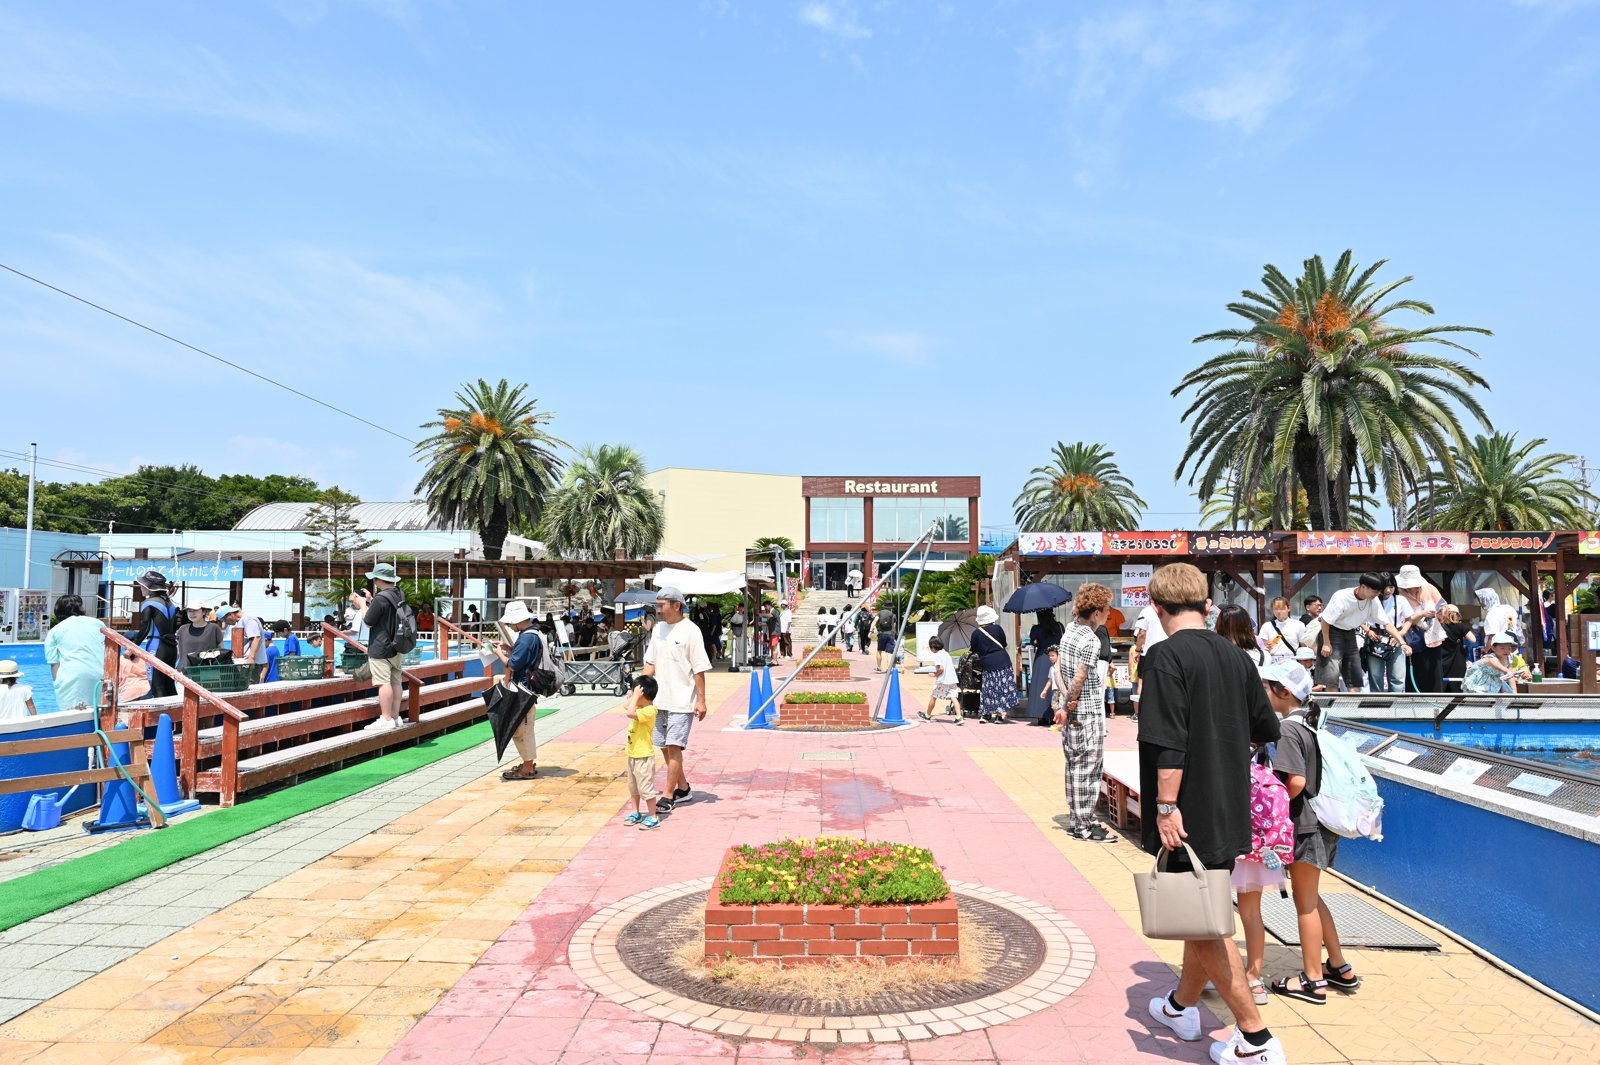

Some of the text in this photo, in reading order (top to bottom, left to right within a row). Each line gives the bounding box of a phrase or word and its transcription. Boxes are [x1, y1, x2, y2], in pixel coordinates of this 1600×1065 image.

[845, 480, 938, 493] Restaurant
[1035, 535, 1087, 552] かき氷
[1111, 539, 1177, 550] 焼きとうもろこし
[1196, 536, 1267, 550] チョコバナナ
[1400, 536, 1453, 549] チュロス
[1470, 536, 1544, 549] フランクフルト
